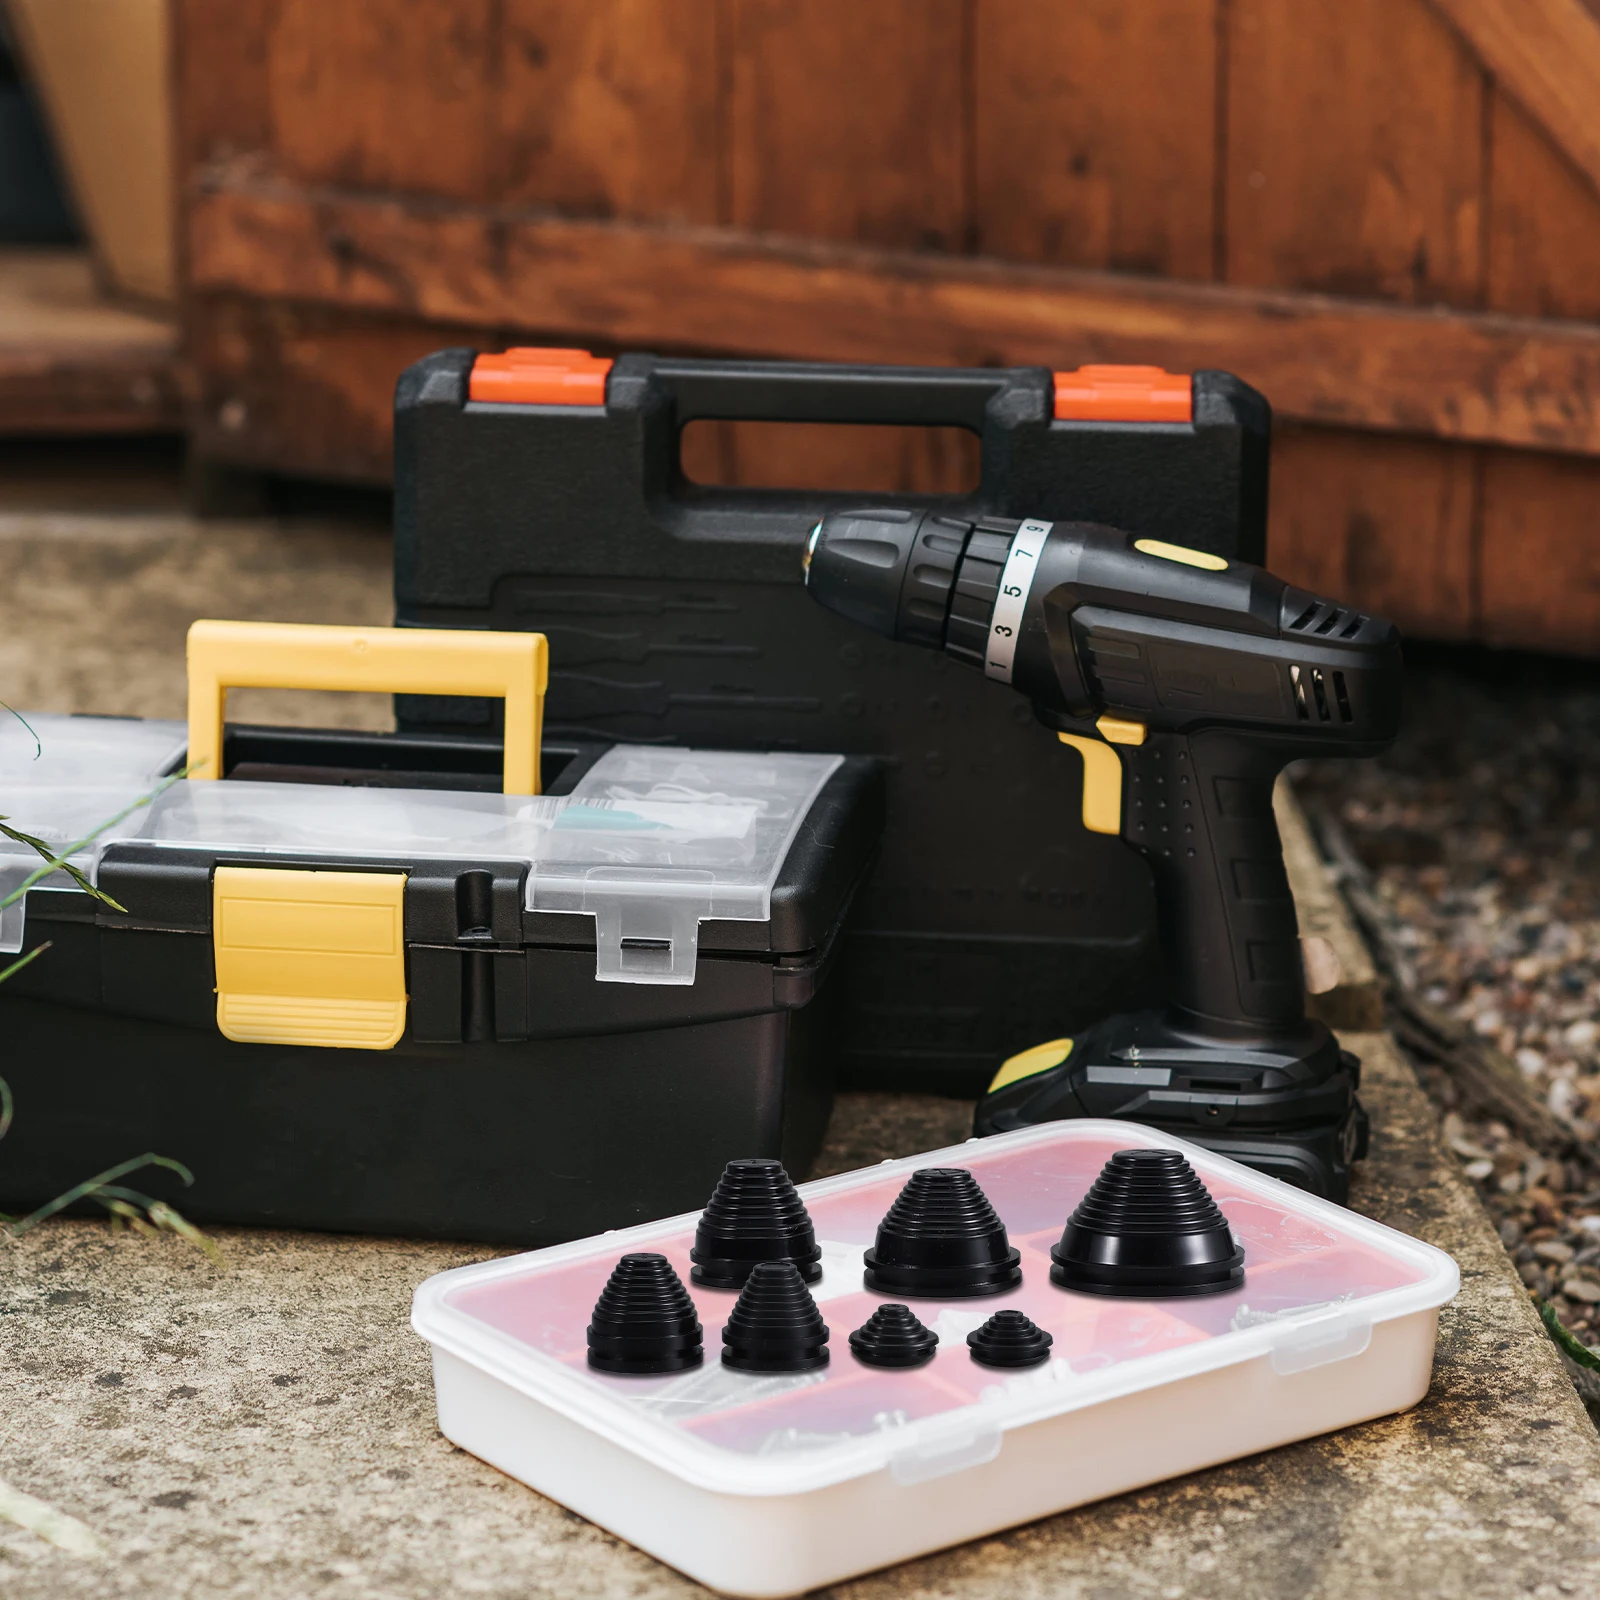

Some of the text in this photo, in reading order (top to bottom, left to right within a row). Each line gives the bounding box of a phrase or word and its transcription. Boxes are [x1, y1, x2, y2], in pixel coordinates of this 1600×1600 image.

[1015, 549, 1033, 558] 7
[1003, 585, 1021, 597] 5
[995, 625, 1012, 637] 3
[989, 661, 1007, 669] 1
